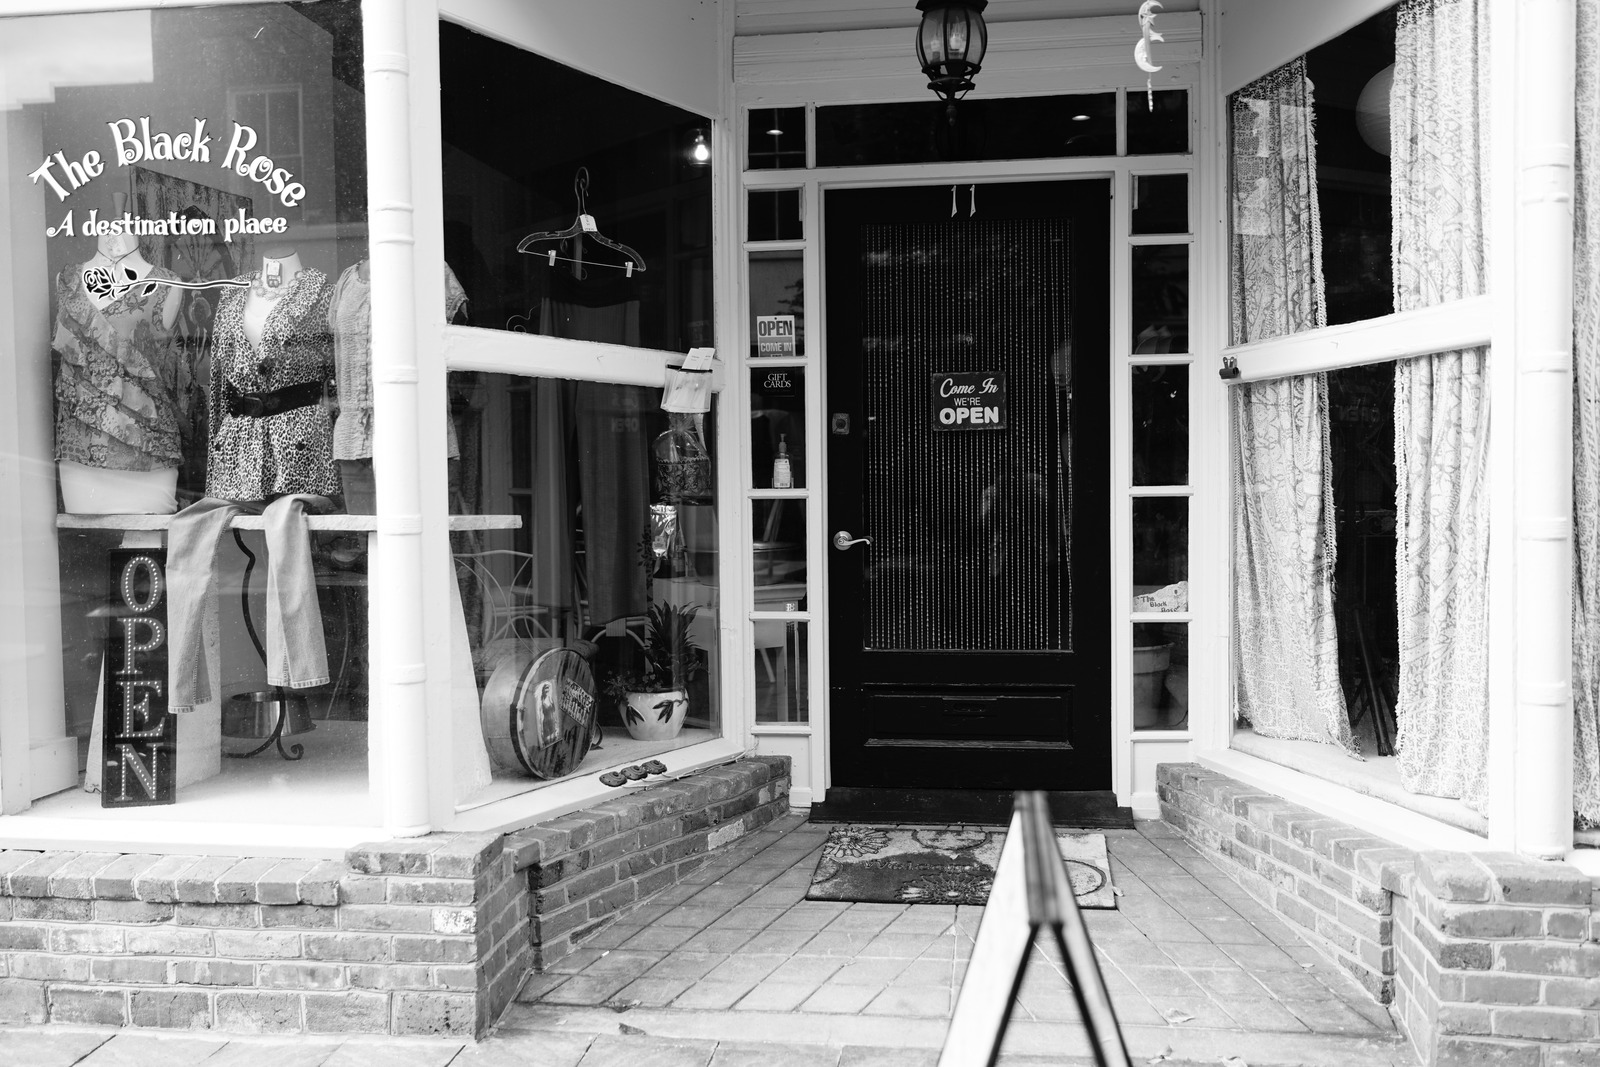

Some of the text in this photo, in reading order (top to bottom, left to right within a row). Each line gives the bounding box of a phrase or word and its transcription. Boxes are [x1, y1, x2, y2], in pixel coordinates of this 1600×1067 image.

[27, 116, 306, 207] The Black Rose
[950, 184, 977, 218] 11
[46, 207, 289, 242] A destination place
[758, 320, 793, 336] OPEN
[760, 342, 792, 352] COME IN
[763, 380, 792, 388] CARDS
[767, 373, 788, 381] GIFT
[940, 377, 999, 398] Come In
[953, 396, 981, 406] WE'RE
[939, 406, 999, 425] OPEN
[114, 555, 166, 802] OPEN
